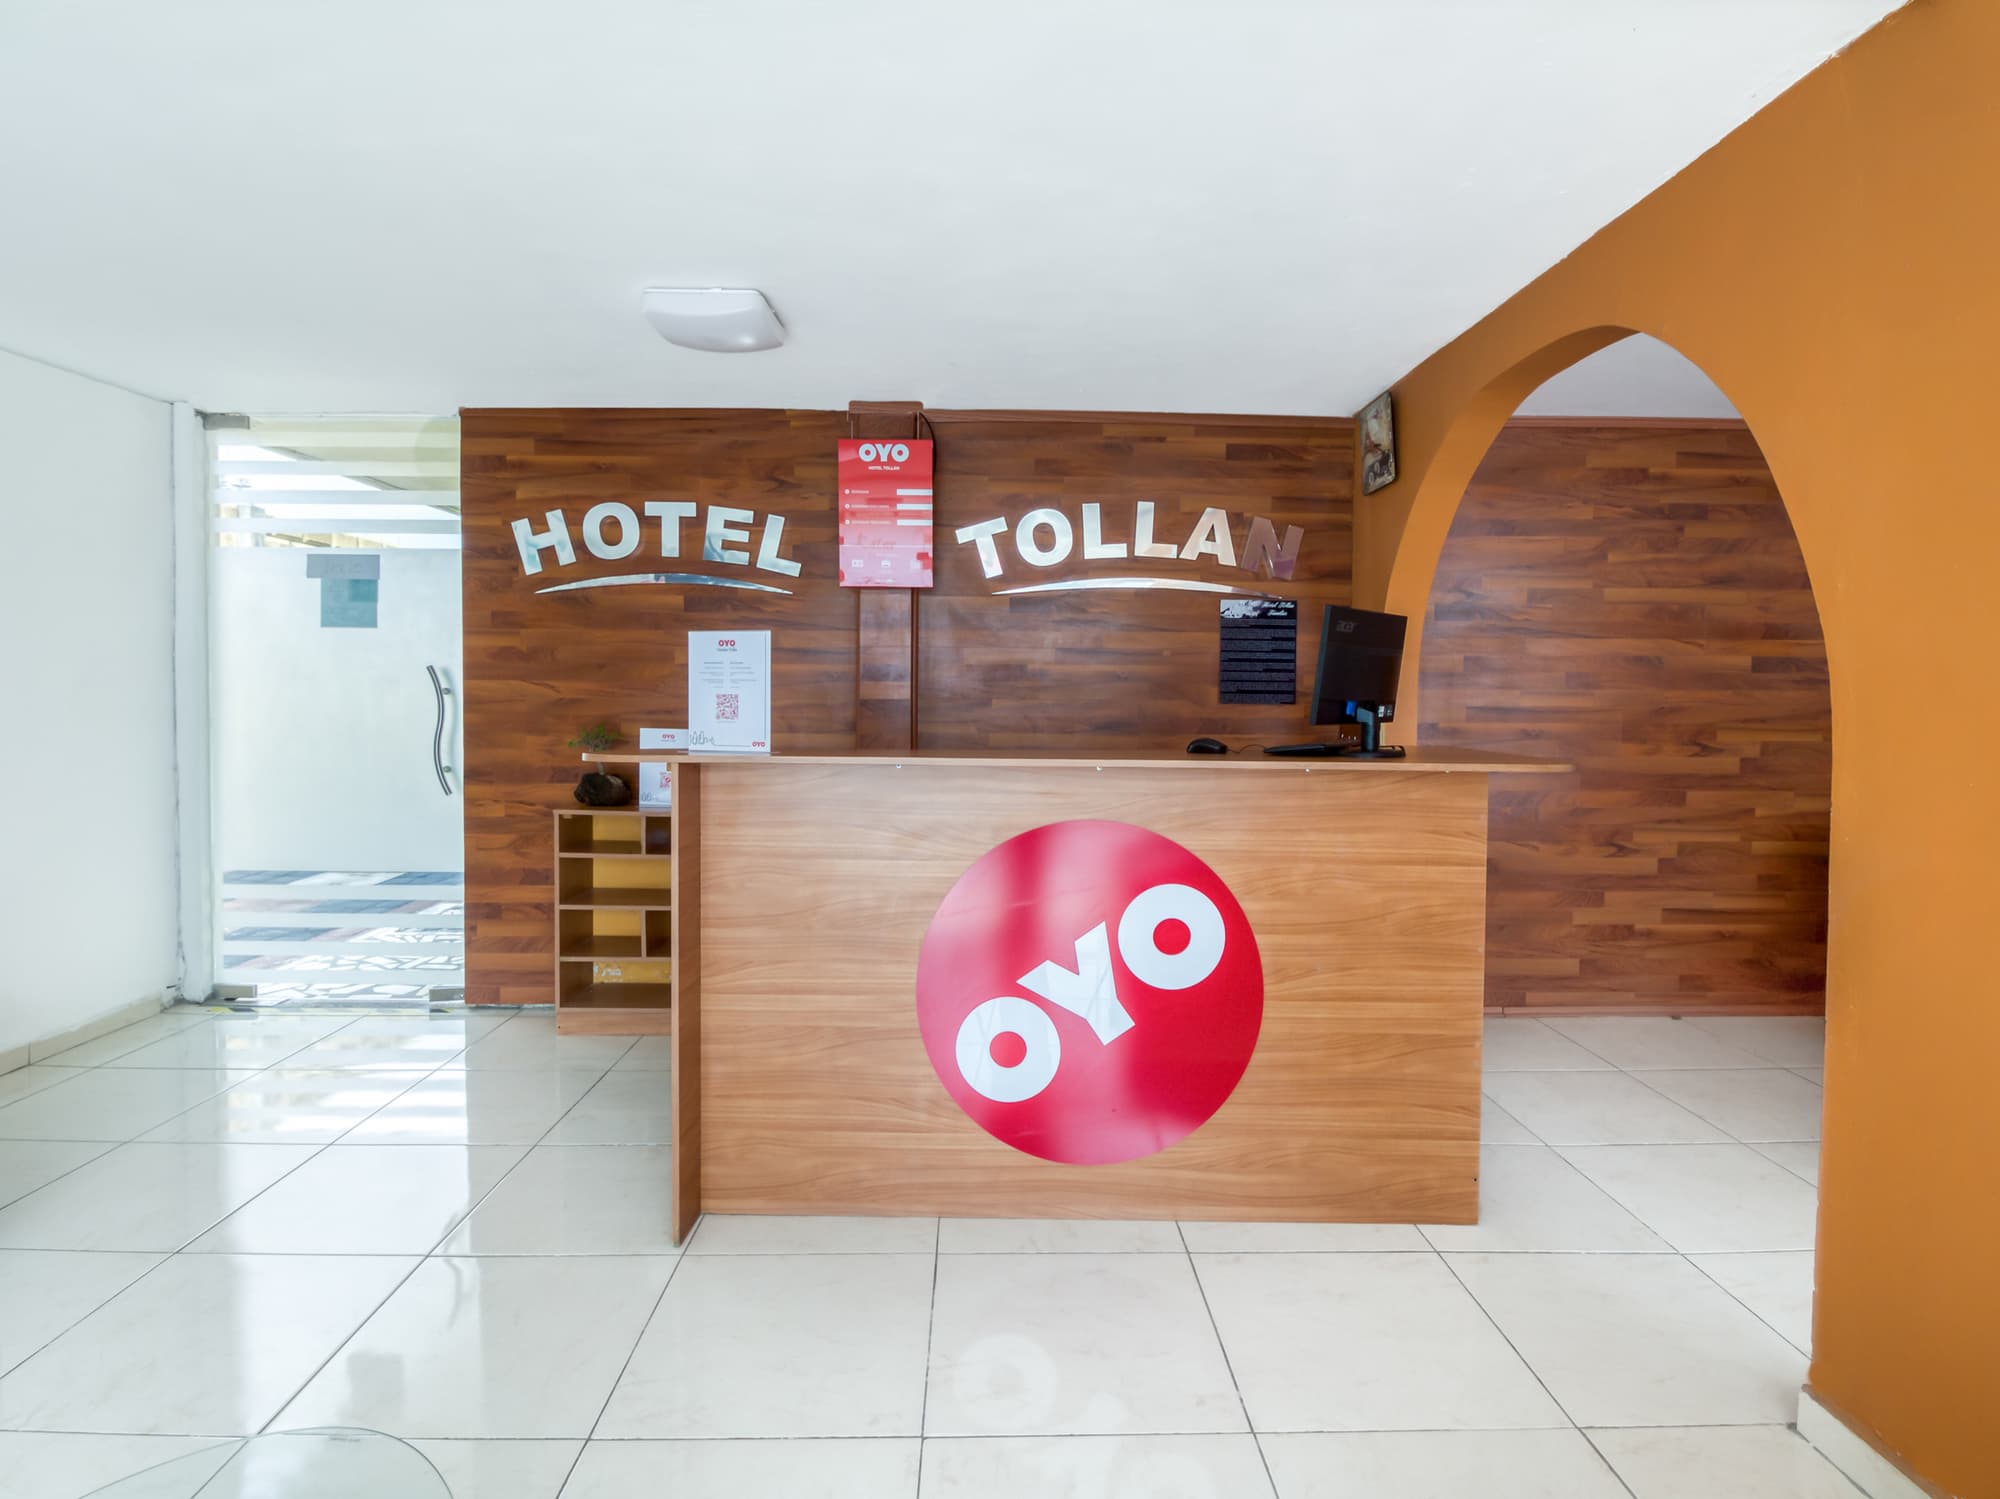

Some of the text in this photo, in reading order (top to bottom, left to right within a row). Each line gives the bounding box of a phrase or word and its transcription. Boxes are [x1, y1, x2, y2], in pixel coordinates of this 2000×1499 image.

[858, 443, 910, 462] OYO
[510, 500, 1305, 581] HOTEL TOLLAN
[955, 883, 1226, 1103] OYO
